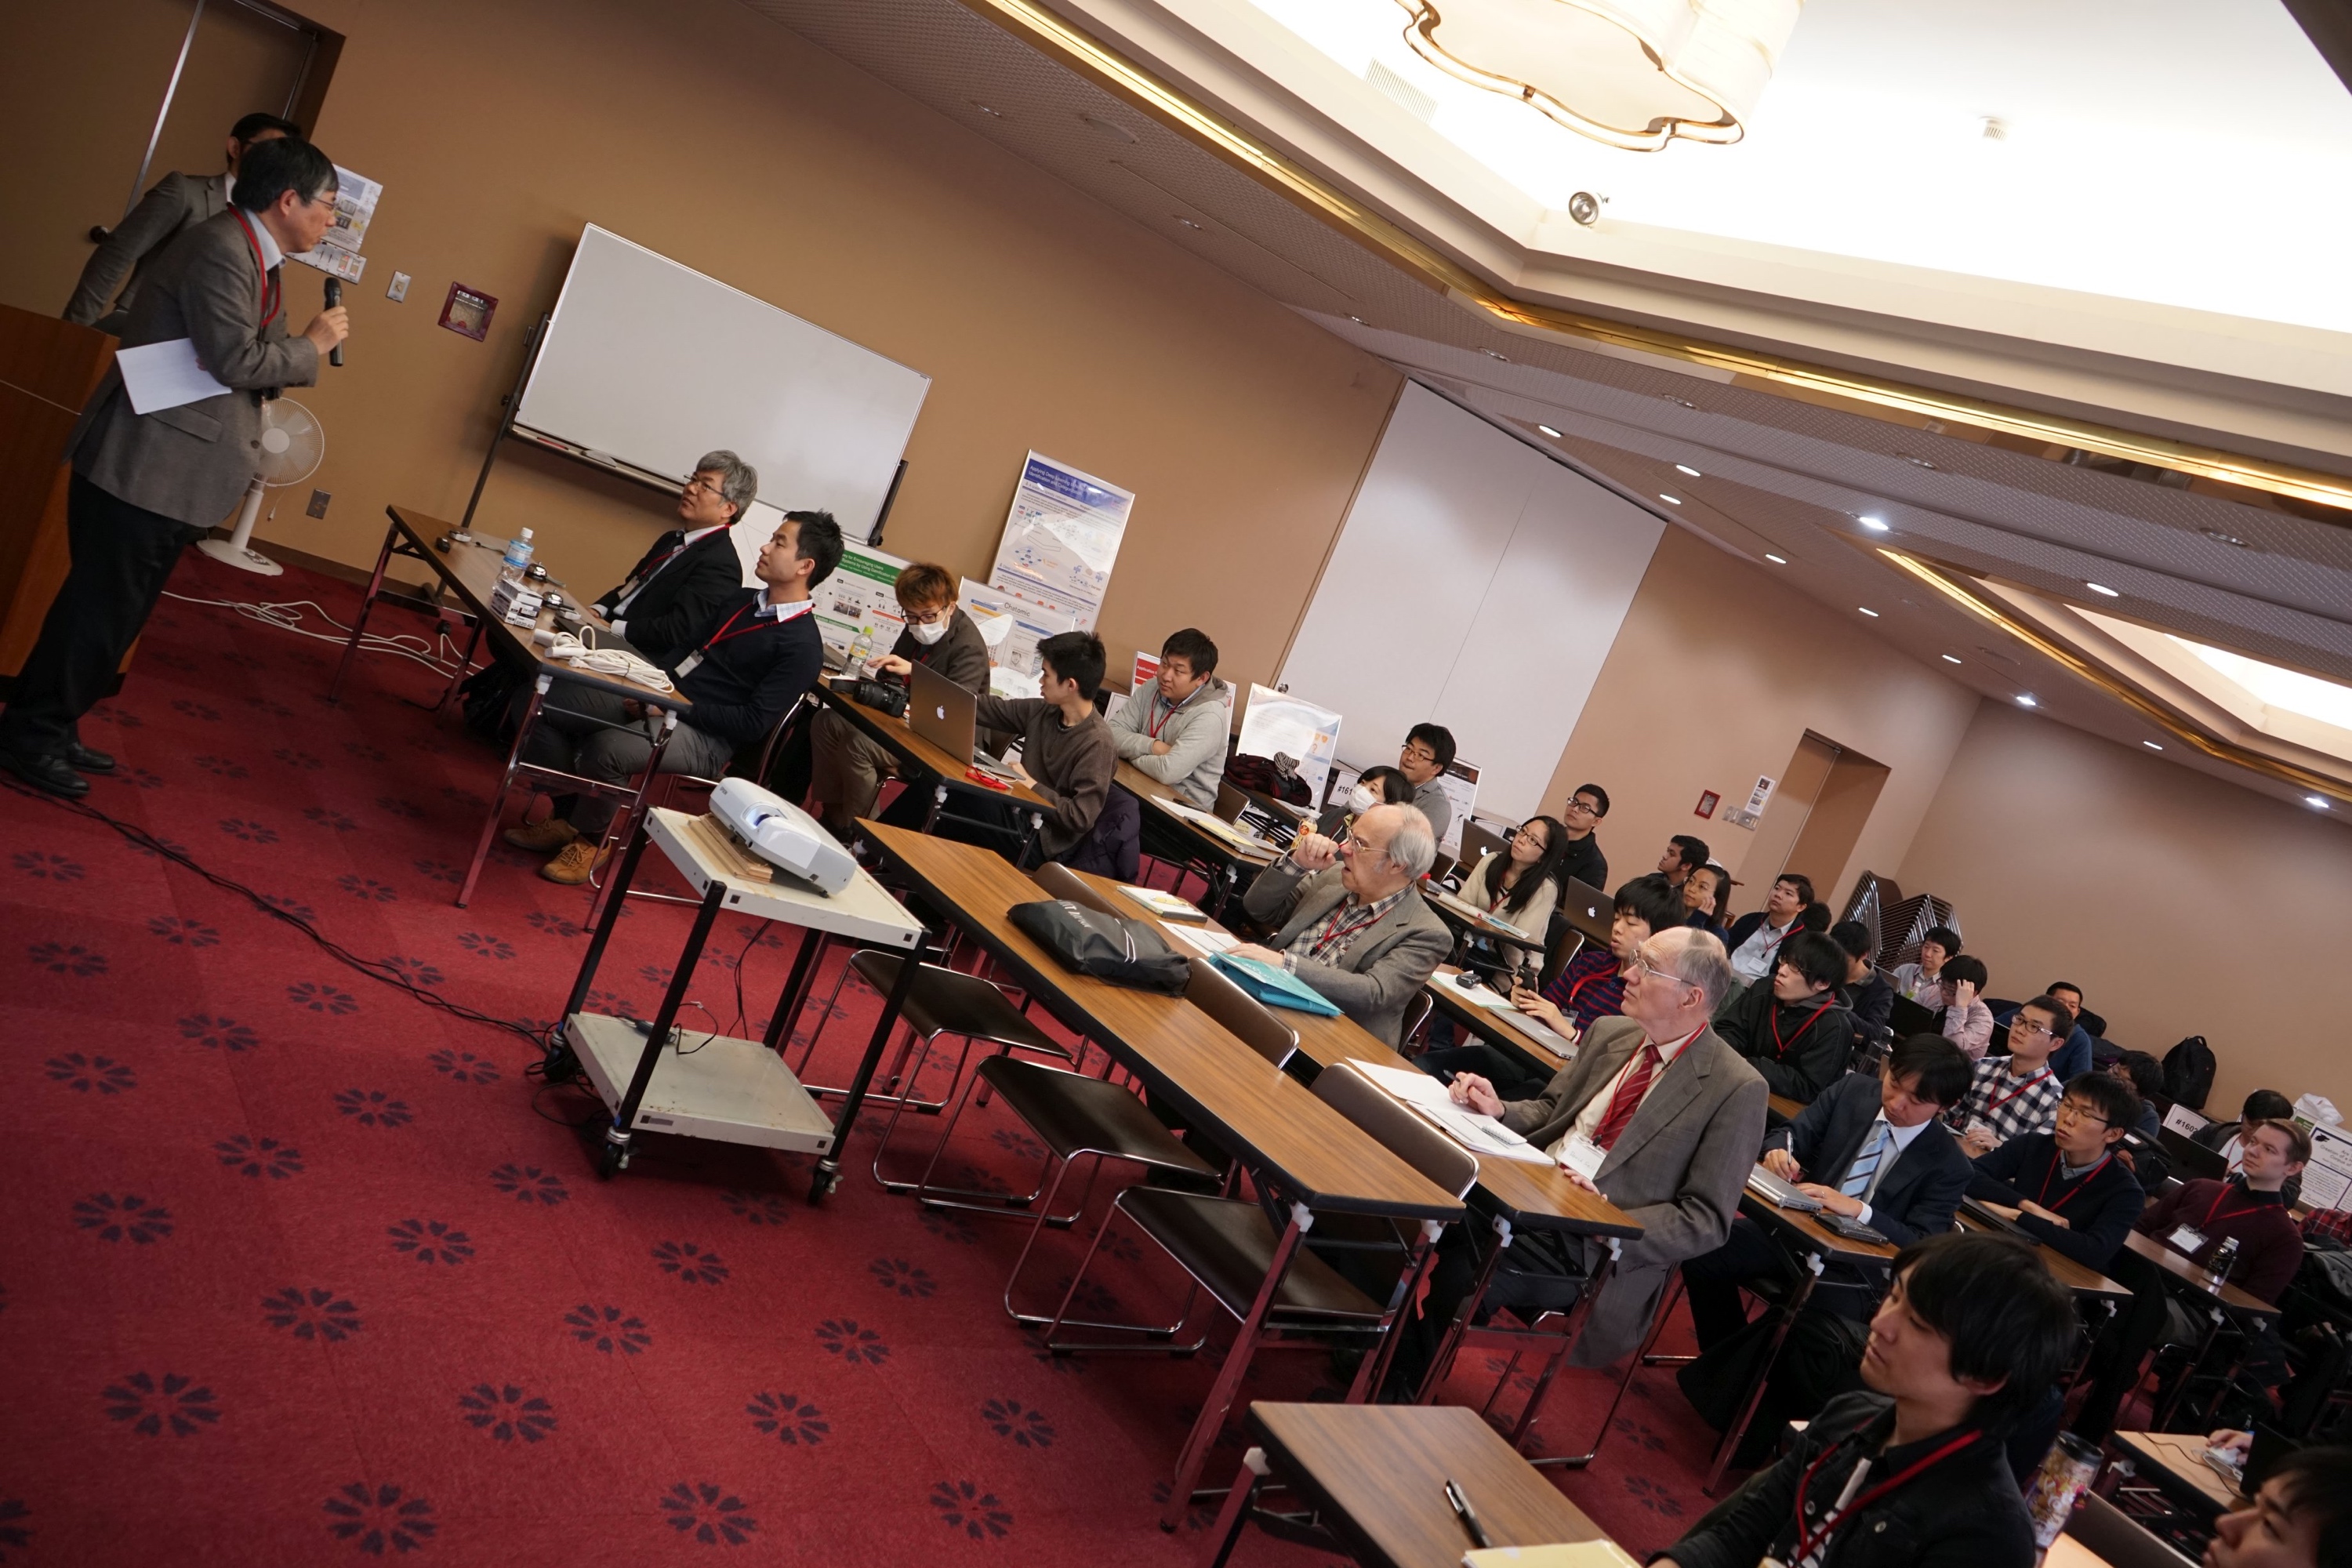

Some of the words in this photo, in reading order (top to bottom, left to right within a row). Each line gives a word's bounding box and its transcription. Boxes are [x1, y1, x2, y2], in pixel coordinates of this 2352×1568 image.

[1029, 470, 1051, 483] Identification
[1045, 471, 1055, 480] Deep
[841, 557, 856, 566] Systems
[870, 568, 891, 578] Gamification
[853, 557, 874, 568] Encouraging
[1004, 601, 1031, 618] Chatomic
[1136, 665, 1155, 674] Application
[2320, 1145, 2339, 1156] Creation
[2330, 1155, 2346, 1164] Corpus
